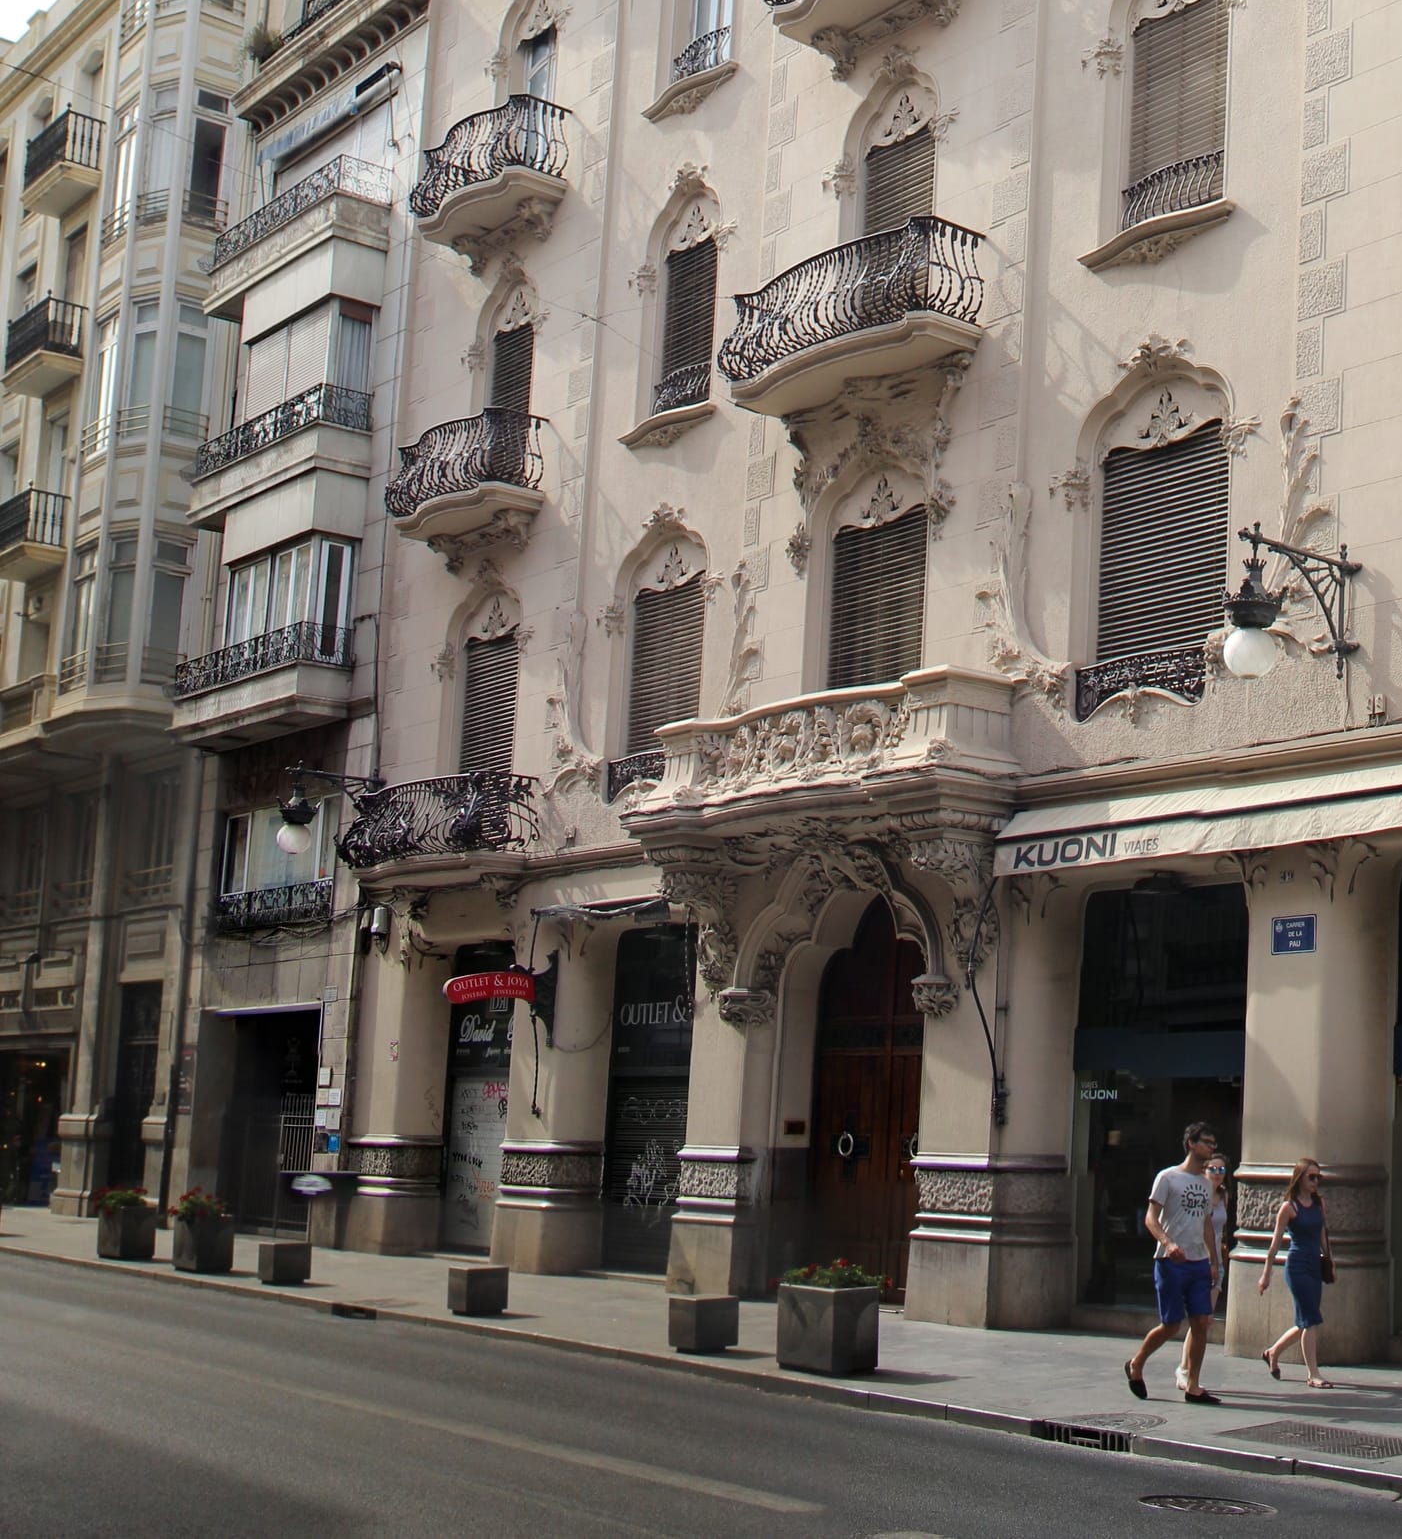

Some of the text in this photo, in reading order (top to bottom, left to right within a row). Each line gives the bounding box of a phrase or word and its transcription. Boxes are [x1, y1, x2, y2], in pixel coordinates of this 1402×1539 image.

[1013, 833, 1159, 869] KUONI VIAJES
[1289, 940, 1301, 948] PAU
[453, 973, 529, 992] OUTLET & JOYA
[620, 995, 687, 1026] OUTLET &
[459, 1014, 496, 1042] David
[1080, 1089, 1118, 1100] KUONI
